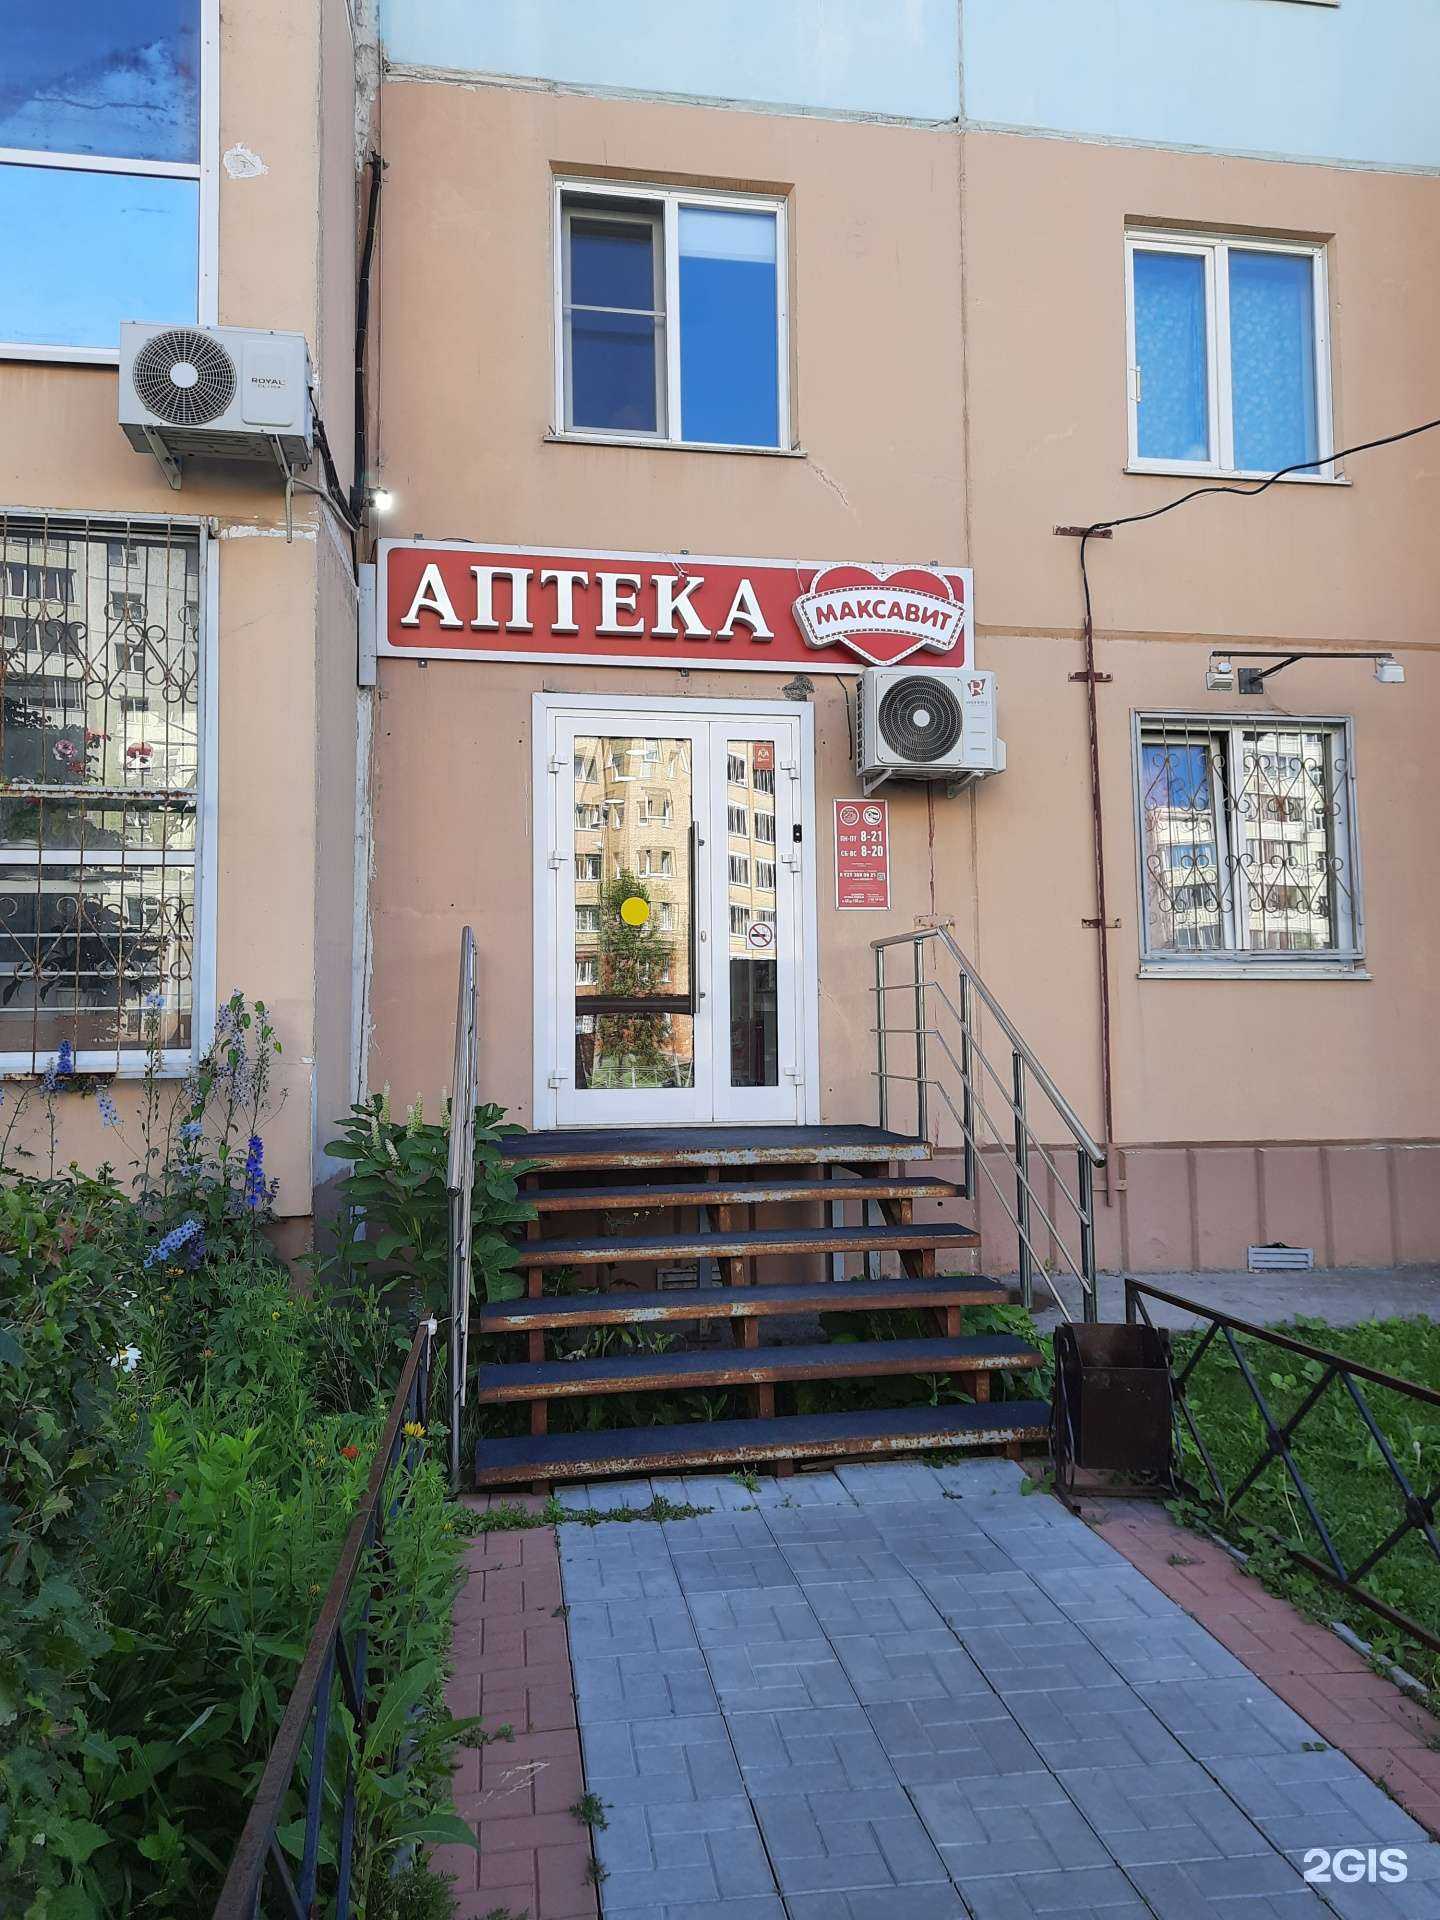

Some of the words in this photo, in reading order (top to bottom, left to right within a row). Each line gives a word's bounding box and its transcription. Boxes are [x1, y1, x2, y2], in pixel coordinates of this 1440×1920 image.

[251, 377, 285, 385] ROYAL
[400, 562, 775, 642] АПТЕКА
[815, 598, 953, 634] МАКСАВИТ
[860, 830, 882, 842] 8-21
[861, 845, 883, 857] 8-20
